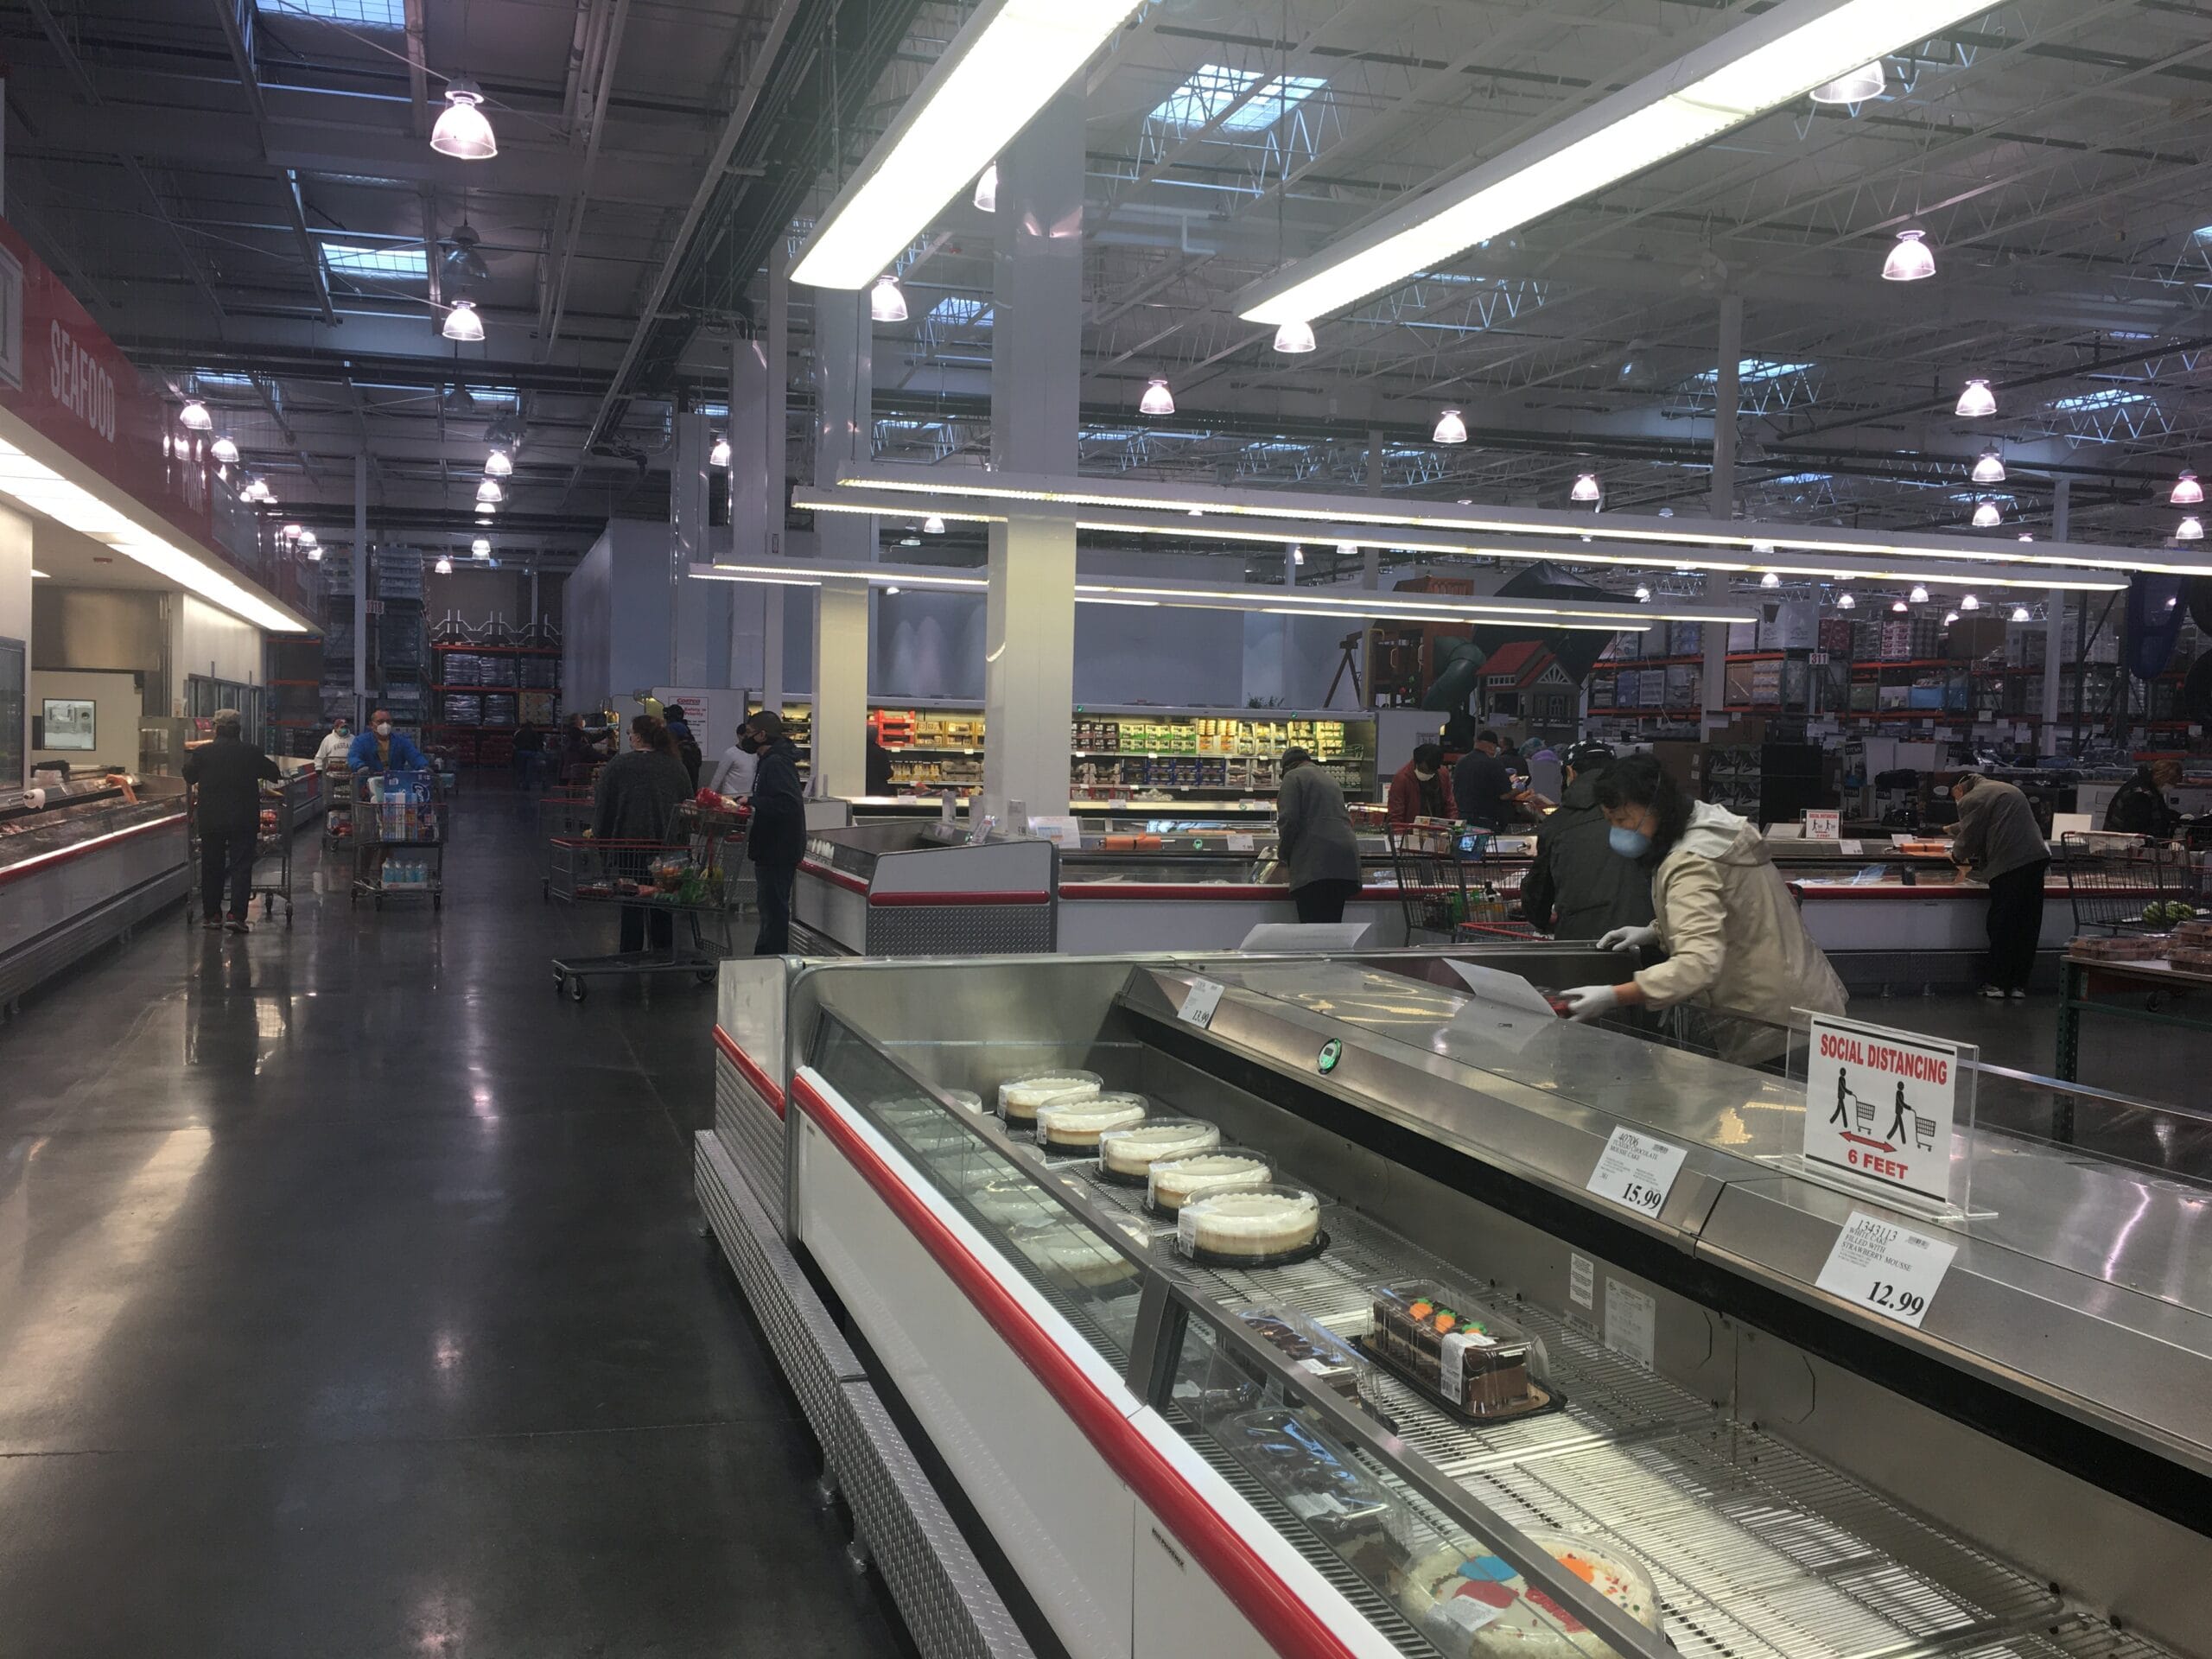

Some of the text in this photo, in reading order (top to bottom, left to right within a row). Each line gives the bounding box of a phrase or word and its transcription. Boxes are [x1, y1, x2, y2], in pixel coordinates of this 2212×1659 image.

[50, 319, 115, 443] SEAFOOD
[1811, 653, 1827, 664] 311
[1821, 1033, 1948, 1085] SOCIAL DISTANCING
[1618, 1133, 1639, 1147] 40706
[1848, 1149, 1909, 1179] 6 FEET
[1623, 1182, 1662, 1209] 15.99
[1848, 1227, 1888, 1246] WHITE CAKE
[1857, 1219, 1898, 1242] 1343113
[1840, 1242, 1884, 1261] STRAWBERRY
[1885, 1256, 1913, 1272] MOUSSE
[1845, 1235, 1886, 1254] FILLED WITH
[1866, 1281, 1925, 1316] 12.99
